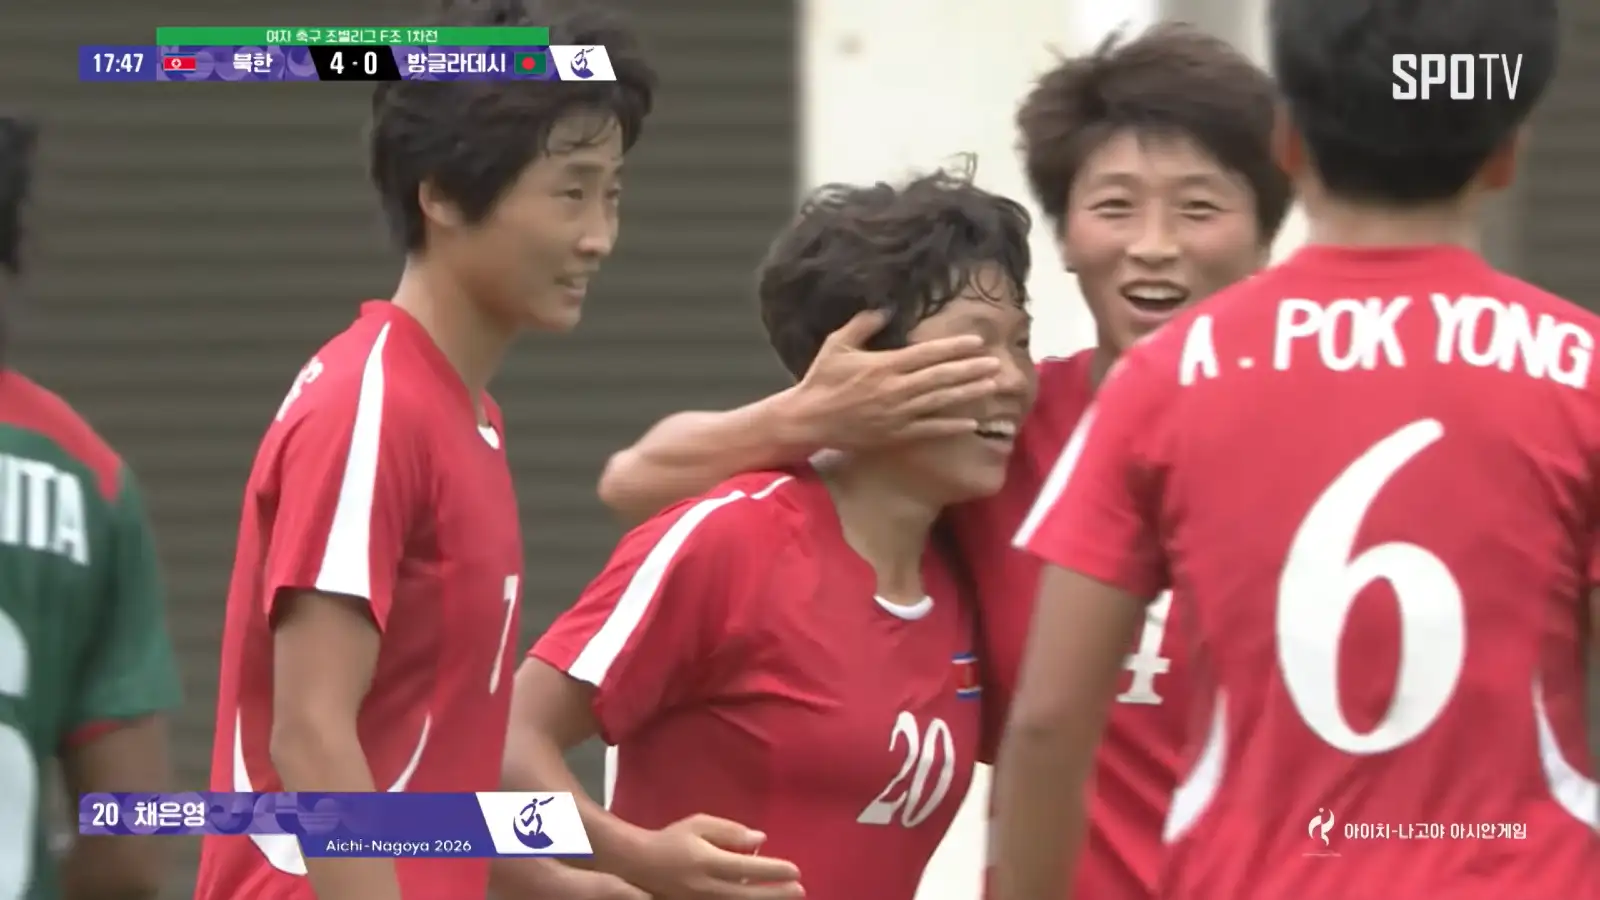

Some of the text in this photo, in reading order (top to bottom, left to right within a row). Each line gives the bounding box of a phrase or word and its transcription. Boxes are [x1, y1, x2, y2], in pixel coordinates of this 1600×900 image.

[1272, 295, 1413, 372] POK
[1429, 291, 1596, 390] YONG
[0, 453, 91, 567] ITA
[488, 575, 520, 694] 7
[1275, 417, 1467, 755] 6
[856, 710, 956, 828] 20
